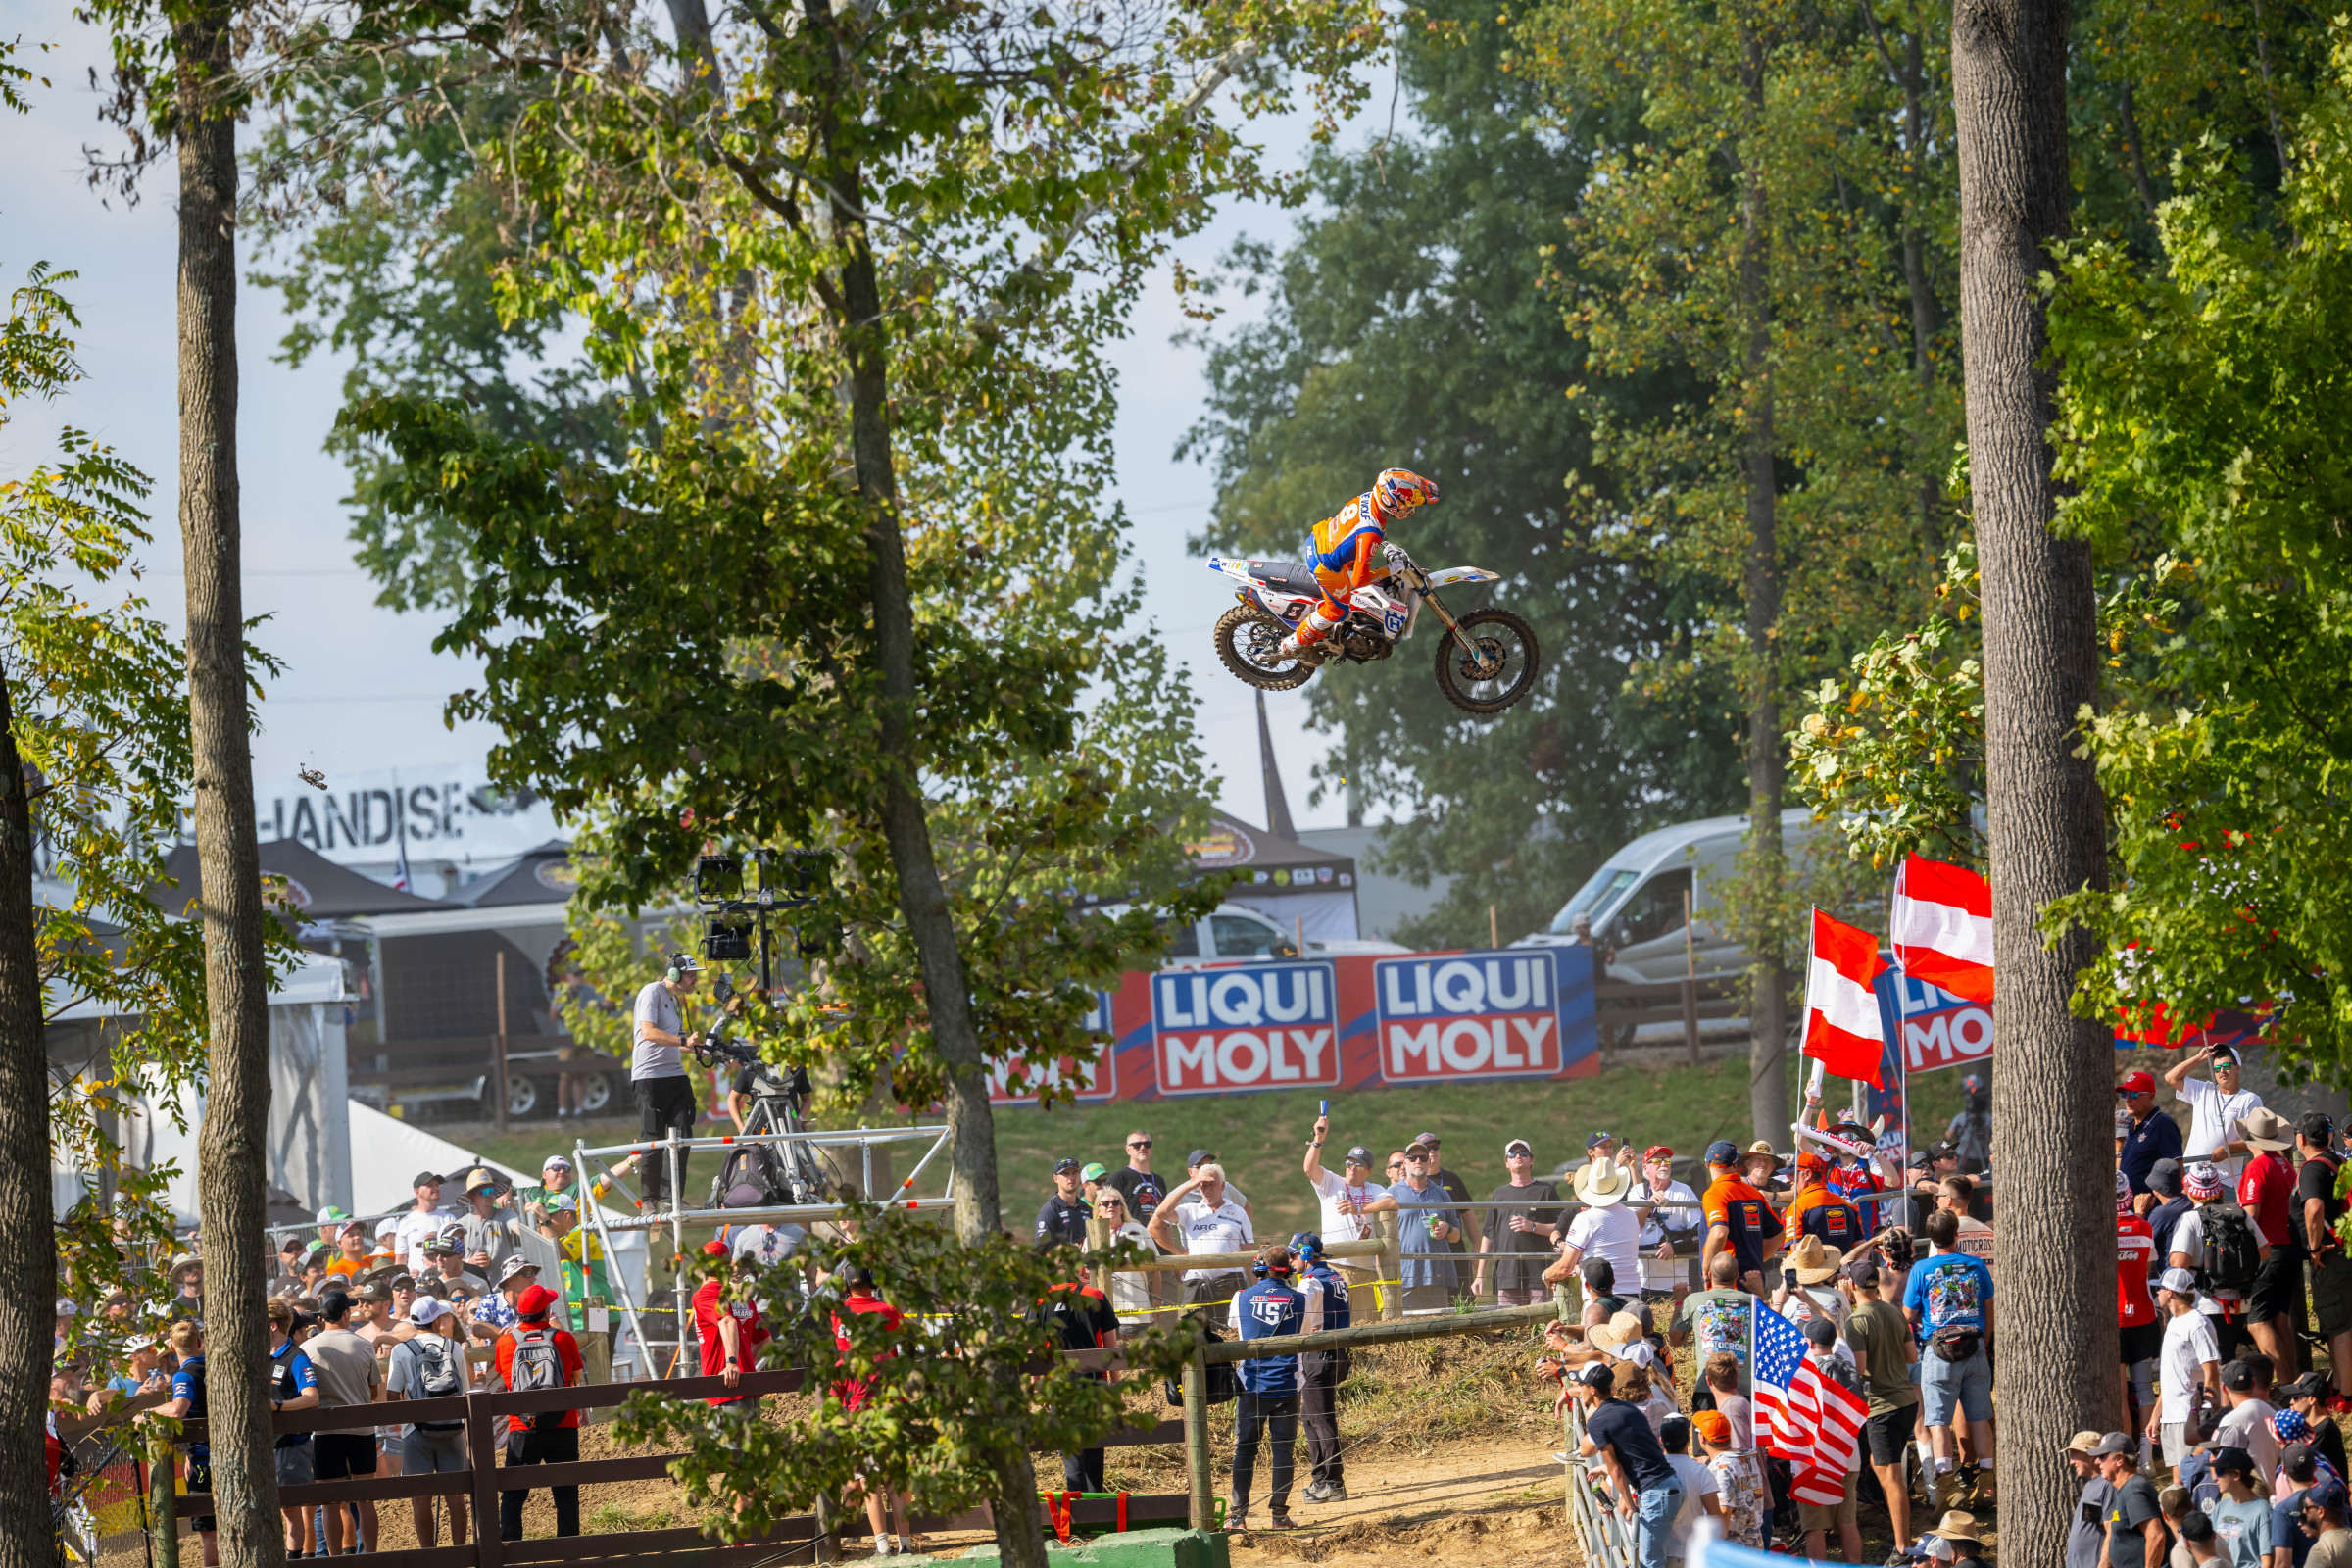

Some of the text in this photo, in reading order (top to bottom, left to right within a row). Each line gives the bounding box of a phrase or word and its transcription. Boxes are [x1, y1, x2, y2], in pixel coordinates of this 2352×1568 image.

[1340, 503, 1358, 525] 8
[1360, 499, 1371, 521] WOLF
[1160, 970, 1327, 1027] LIQUI
[1385, 957, 1548, 1015] LIQUI
[1165, 1029, 1333, 1087] MOLY
[1389, 1016, 1555, 1074] MOLY
[1192, 1223, 1218, 1232] ARG
